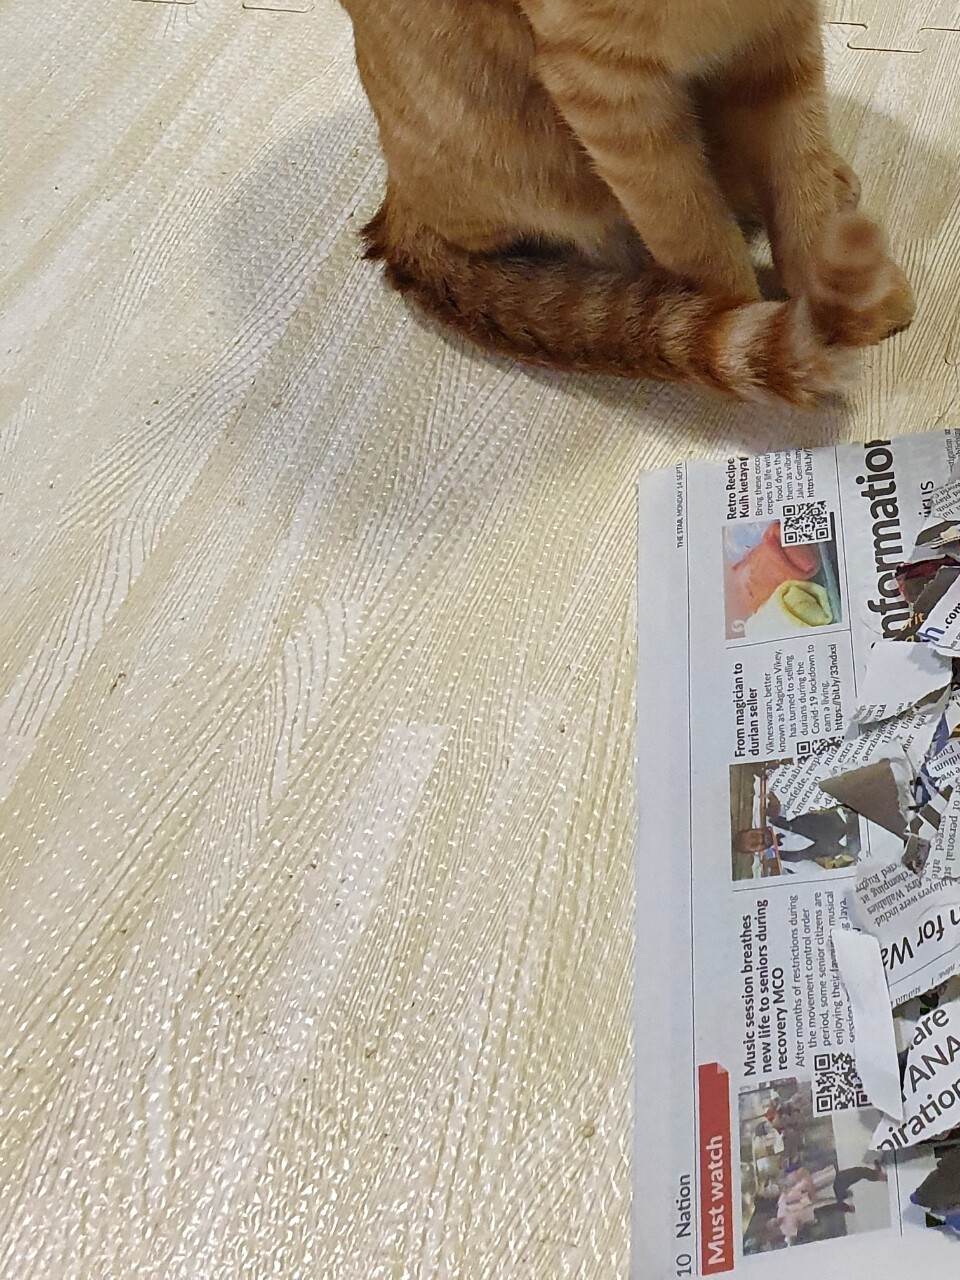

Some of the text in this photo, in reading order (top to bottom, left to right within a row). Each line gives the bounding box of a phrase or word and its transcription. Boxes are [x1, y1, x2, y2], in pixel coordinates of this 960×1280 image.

[726, 492, 737, 520] Retro
[738, 494, 750, 518] Kuih
[754, 476, 764, 516] Bring these
[764, 468, 774, 514] crepes to life
[774, 467, 784, 502] food dyes
[786, 472, 794, 500] them as
[676, 535, 684, 548] THE
[856, 440, 911, 644] nformatio
[732, 663, 746, 758] From magician to
[775, 674, 786, 711] Magician
[785, 654, 797, 738] has turned to selling
[796, 661, 808, 736] durians during the
[808, 644, 820, 734] Covid-19 lockdown to
[820, 680, 830, 704] living.
[747, 688, 760, 756] durian seller
[764, 672, 774, 755] Vikneswaran, better
[778, 713, 785, 722] as
[824, 714, 832, 732] earn
[778, 724, 786, 752] known
[945, 814, 960, 862] personal
[824, 890, 836, 926] musical
[916, 915, 944, 946] for
[754, 899, 772, 1073] new life to seniors during
[788, 895, 805, 1068] After months of restrictions during
[802, 908, 818, 1048] the movement control order
[814, 892, 832, 1046] period, some senior citizens are
[830, 975, 841, 998] their
[740, 914, 756, 1076] Music session breathes
[772, 967, 788, 1070] recovery MCO
[832, 1000, 844, 1045] enjoying
[910, 1009, 950, 1046] are
[706, 1135, 726, 1265] Must watch
[676, 1174, 692, 1277] 10 Nation
